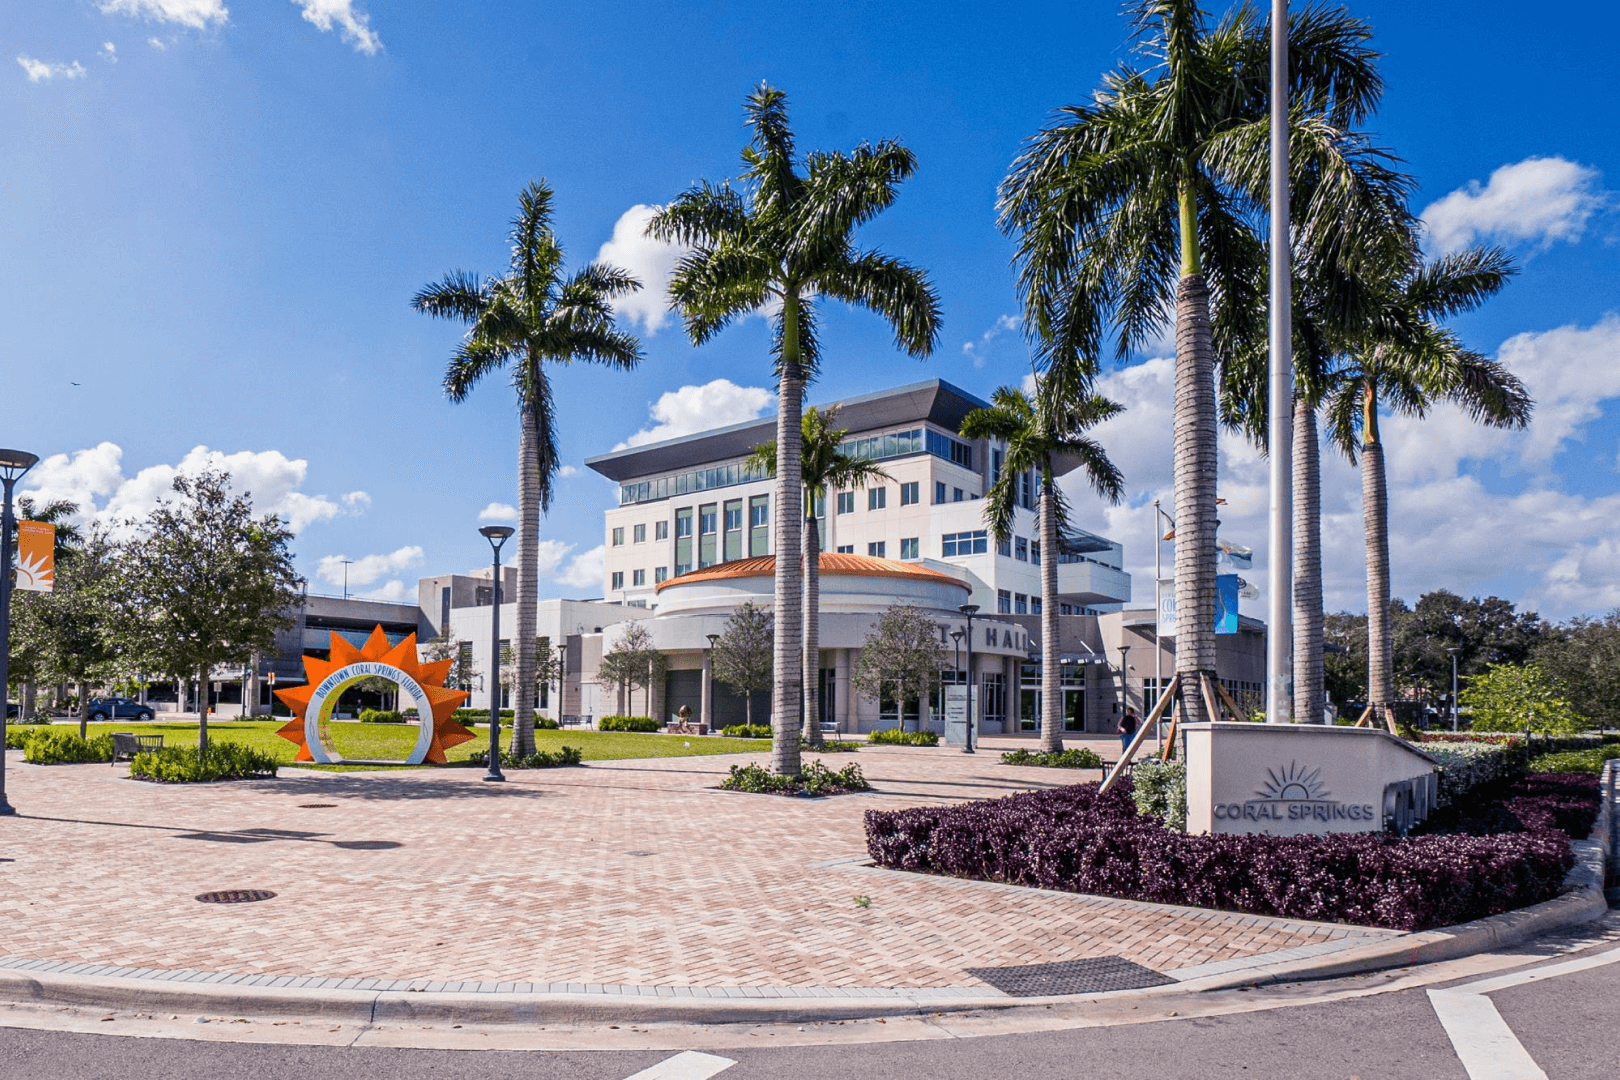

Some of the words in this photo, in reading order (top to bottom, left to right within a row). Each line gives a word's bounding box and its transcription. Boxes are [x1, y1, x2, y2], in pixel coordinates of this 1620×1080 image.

[986, 627, 1028, 651] HALL
[315, 669, 350, 699] DOWNTOWN
[351, 663, 371, 676] CORAL
[373, 664, 402, 681] SPRINGS
[401, 676, 424, 701] FLORIDA
[1214, 803, 1283, 822] CORAL
[1287, 803, 1374, 822] SPRINGS
